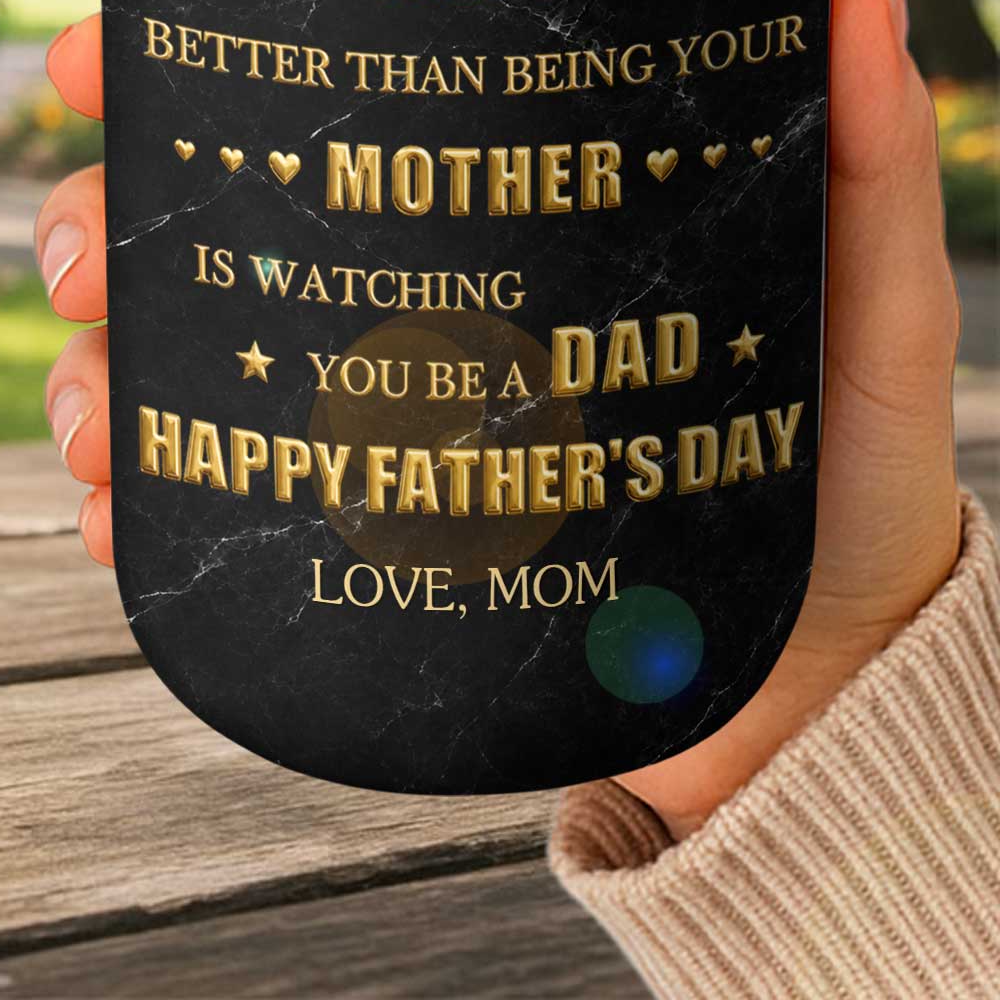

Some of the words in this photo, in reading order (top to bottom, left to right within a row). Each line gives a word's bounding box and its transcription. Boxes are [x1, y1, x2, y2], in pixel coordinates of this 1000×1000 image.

[143, 18, 334, 90] BETTER
[346, 52, 486, 96] THAN
[503, 43, 656, 96] BEING
[667, 15, 807, 83] YOUR
[326, 140, 622, 216] MOTHER
[194, 244, 235, 289] IS
[248, 255, 527, 311] WATCHING
[307, 352, 411, 398] YOU
[426, 361, 488, 400] BE
[497, 368, 532, 400] A
[552, 312, 700, 397] DAD
[138, 405, 352, 510] HAPPY
[366, 435, 663, 516] FATHER'S
[677, 402, 805, 494] DAY
[310, 558, 468, 619] LOVE,
[487, 557, 619, 611] MOM
